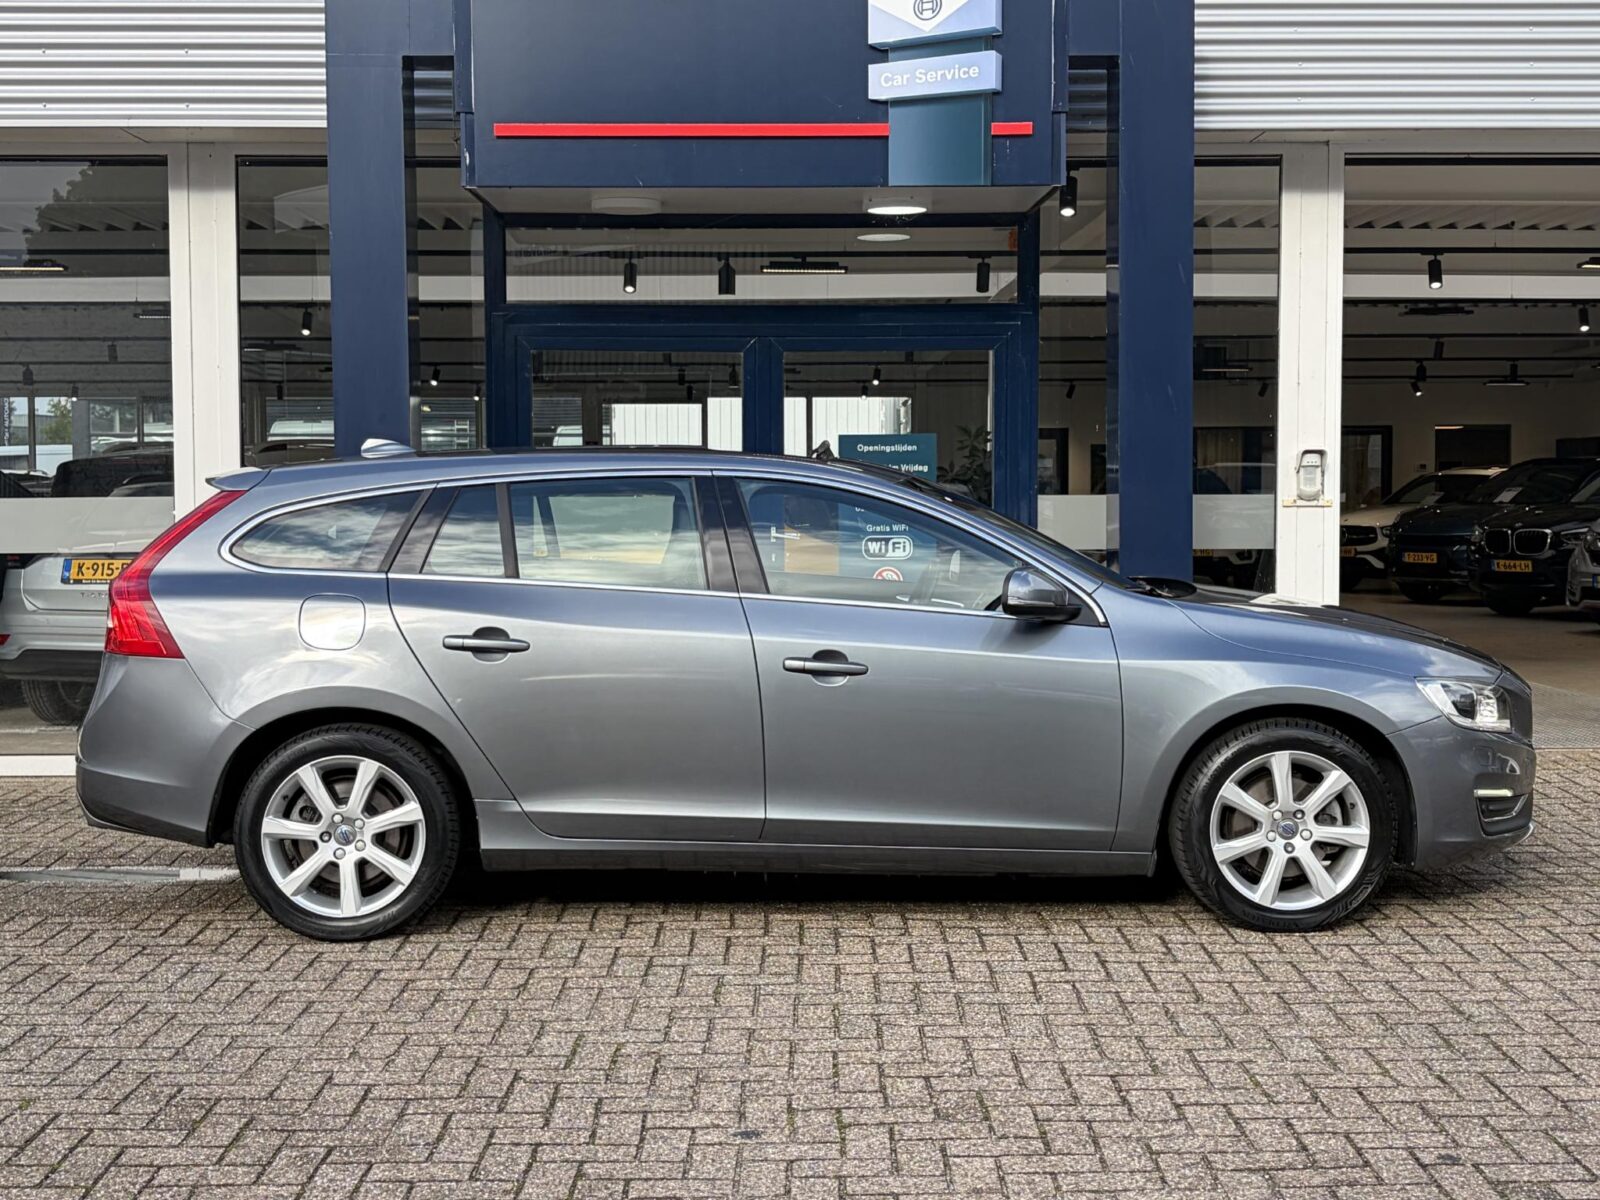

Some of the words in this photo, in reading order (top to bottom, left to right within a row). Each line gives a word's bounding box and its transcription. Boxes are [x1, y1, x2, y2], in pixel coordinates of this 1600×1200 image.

[880, 72, 911, 87] Car
[915, 64, 980, 84] Service
[857, 443, 918, 453] Openingstijden
[900, 463, 929, 472] Vrijdag
[866, 523, 891, 532] Gratis
[892, 523, 909, 532] WiFi
